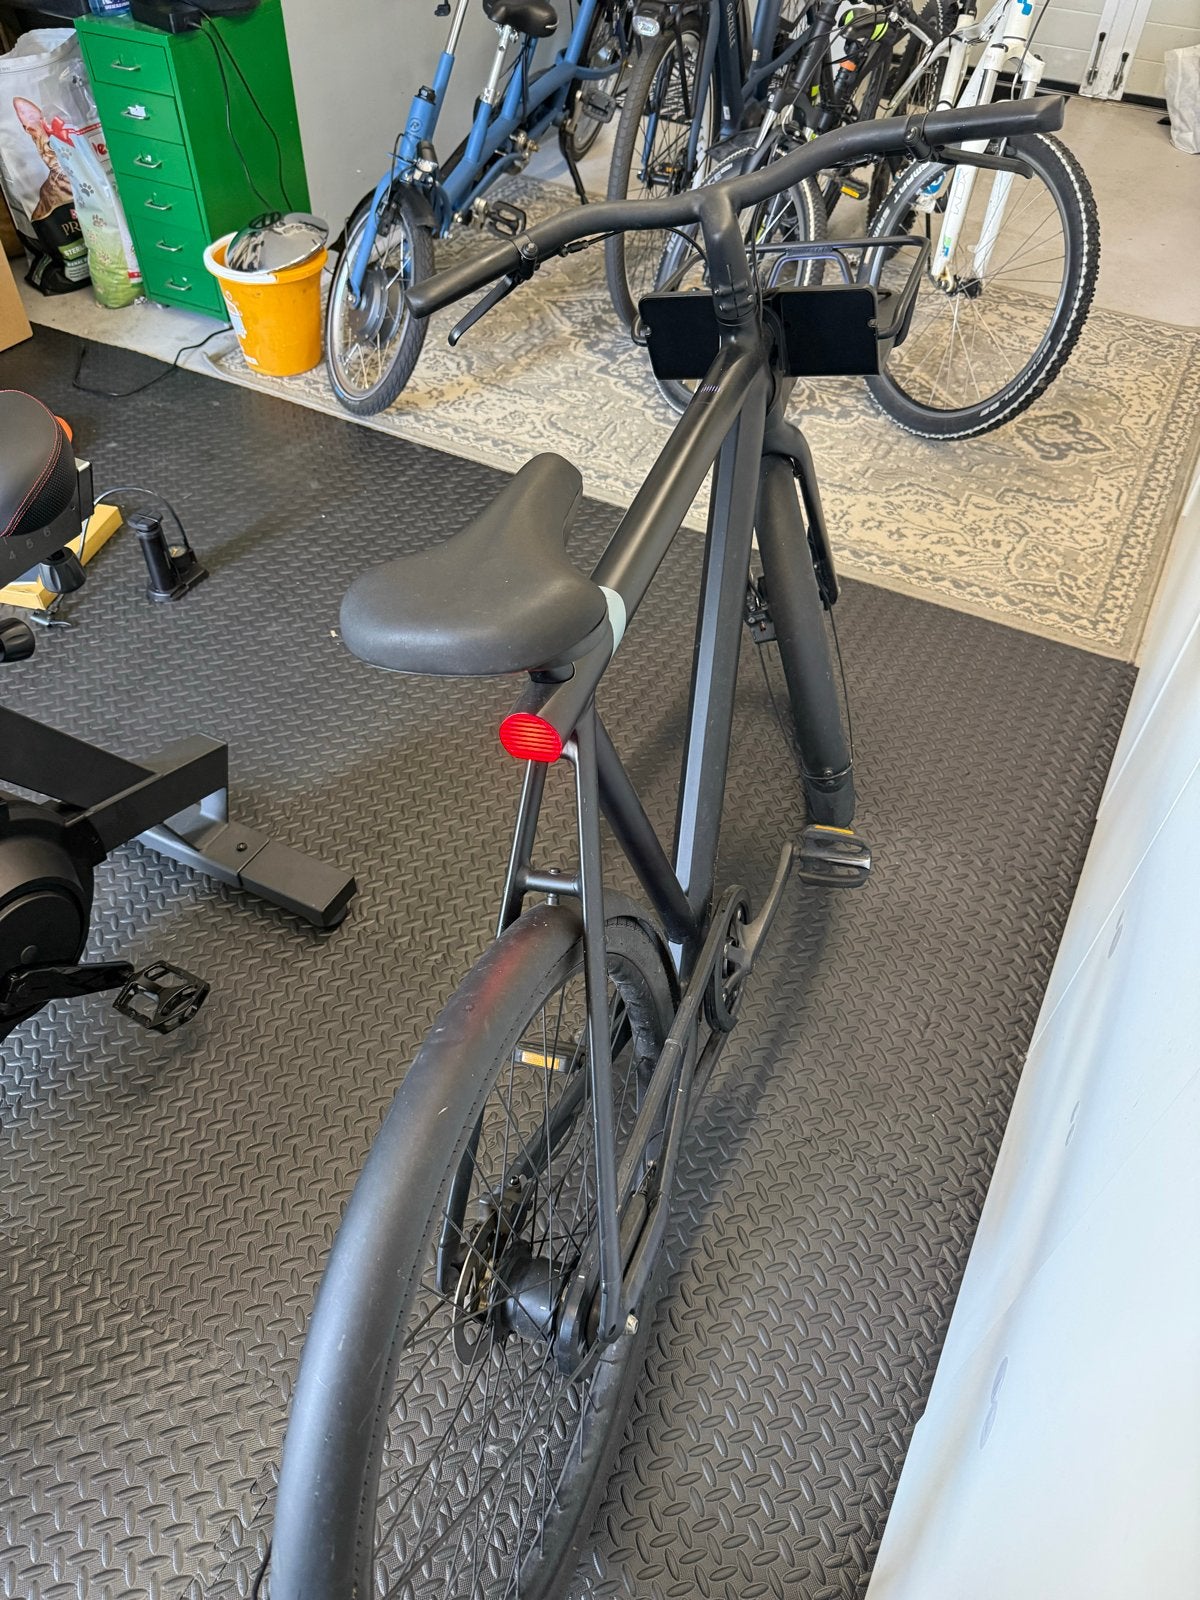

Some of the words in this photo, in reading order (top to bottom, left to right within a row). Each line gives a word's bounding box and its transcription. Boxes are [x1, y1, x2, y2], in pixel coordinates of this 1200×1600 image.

[726, 2, 736, 49] GAZELLE
[893, 160, 931, 204] SMART
[61, 221, 82, 236] PR
[979, 340, 1051, 417] SCHWALBE
